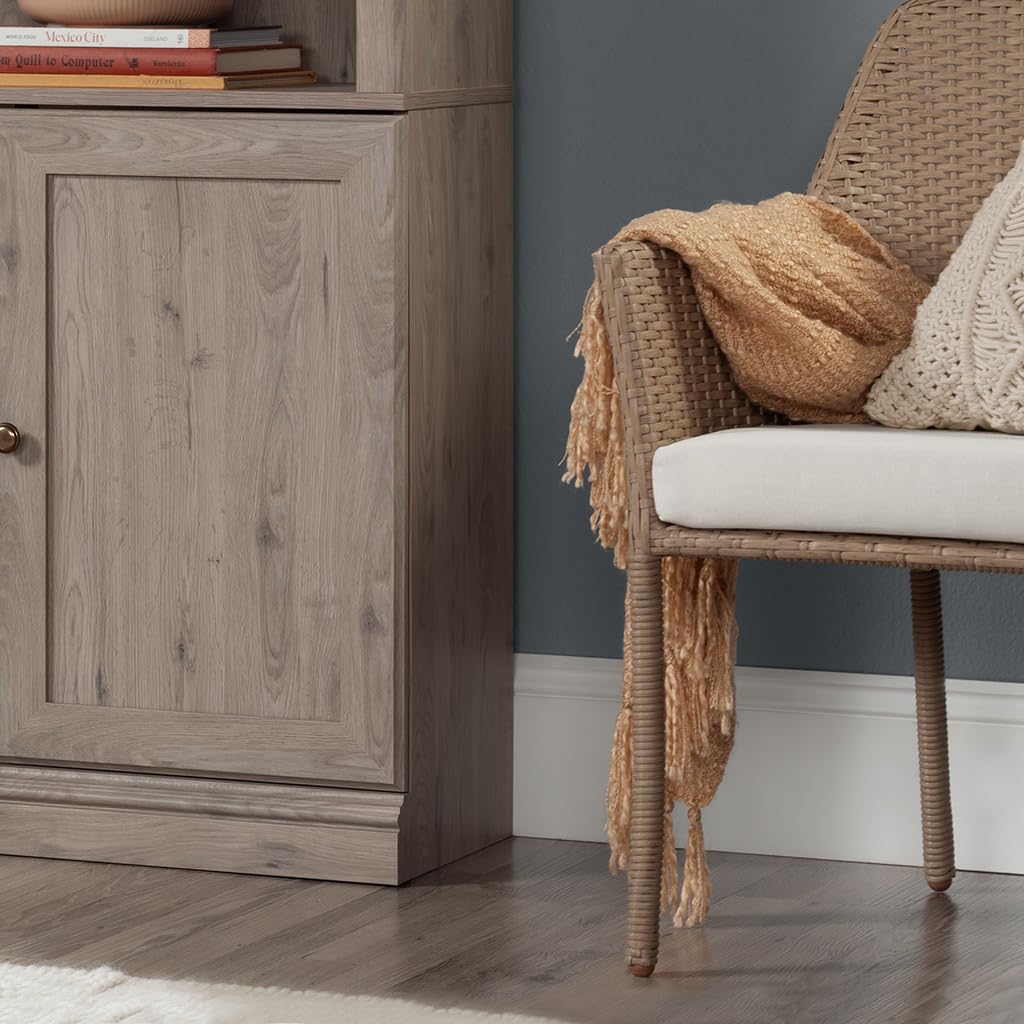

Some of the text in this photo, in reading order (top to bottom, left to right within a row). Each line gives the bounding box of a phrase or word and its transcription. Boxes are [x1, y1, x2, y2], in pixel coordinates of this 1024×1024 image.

[45, 30, 105, 46] Mexico City
[15, 52, 41, 68] Quill
[46, 54, 57, 67] to
[61, 54, 115, 70] Computer
